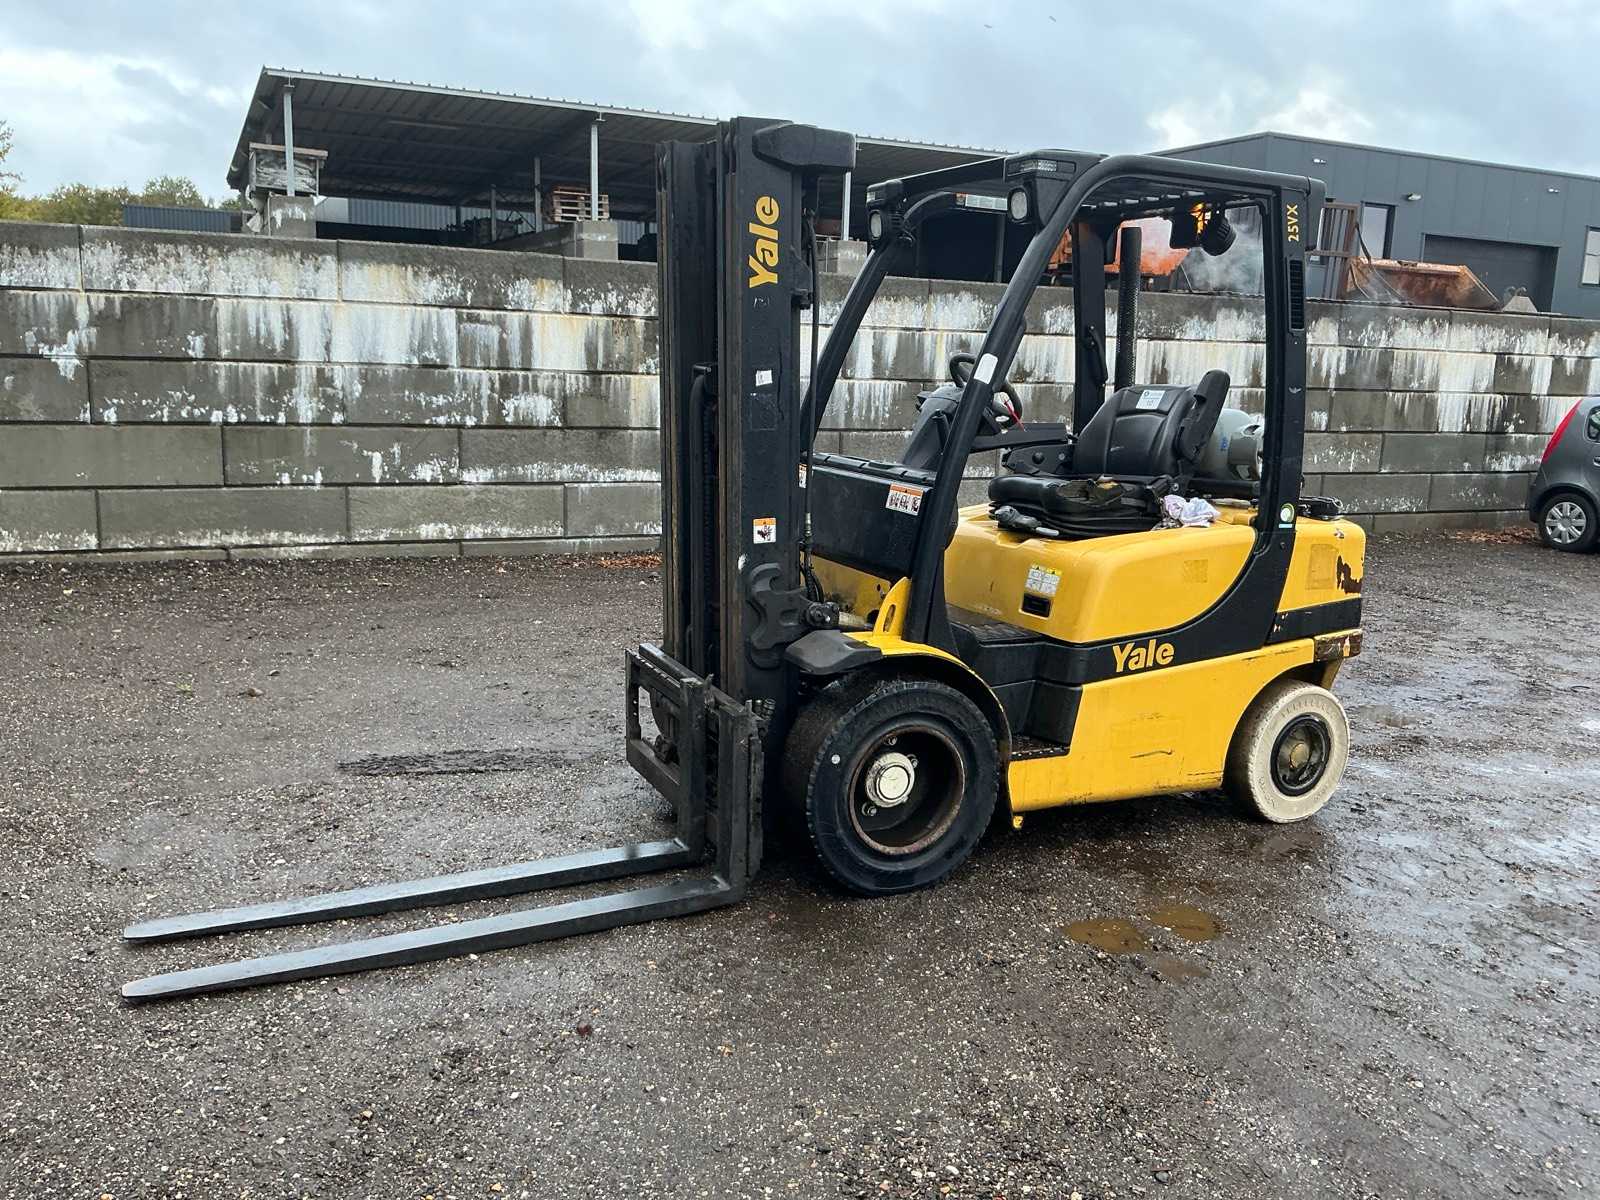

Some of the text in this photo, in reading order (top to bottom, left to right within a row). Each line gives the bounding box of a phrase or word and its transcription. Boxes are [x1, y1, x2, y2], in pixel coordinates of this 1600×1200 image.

[748, 196, 780, 288] Yale
[1286, 204, 1300, 242] 25VX
[1112, 639, 1175, 672] Yale
